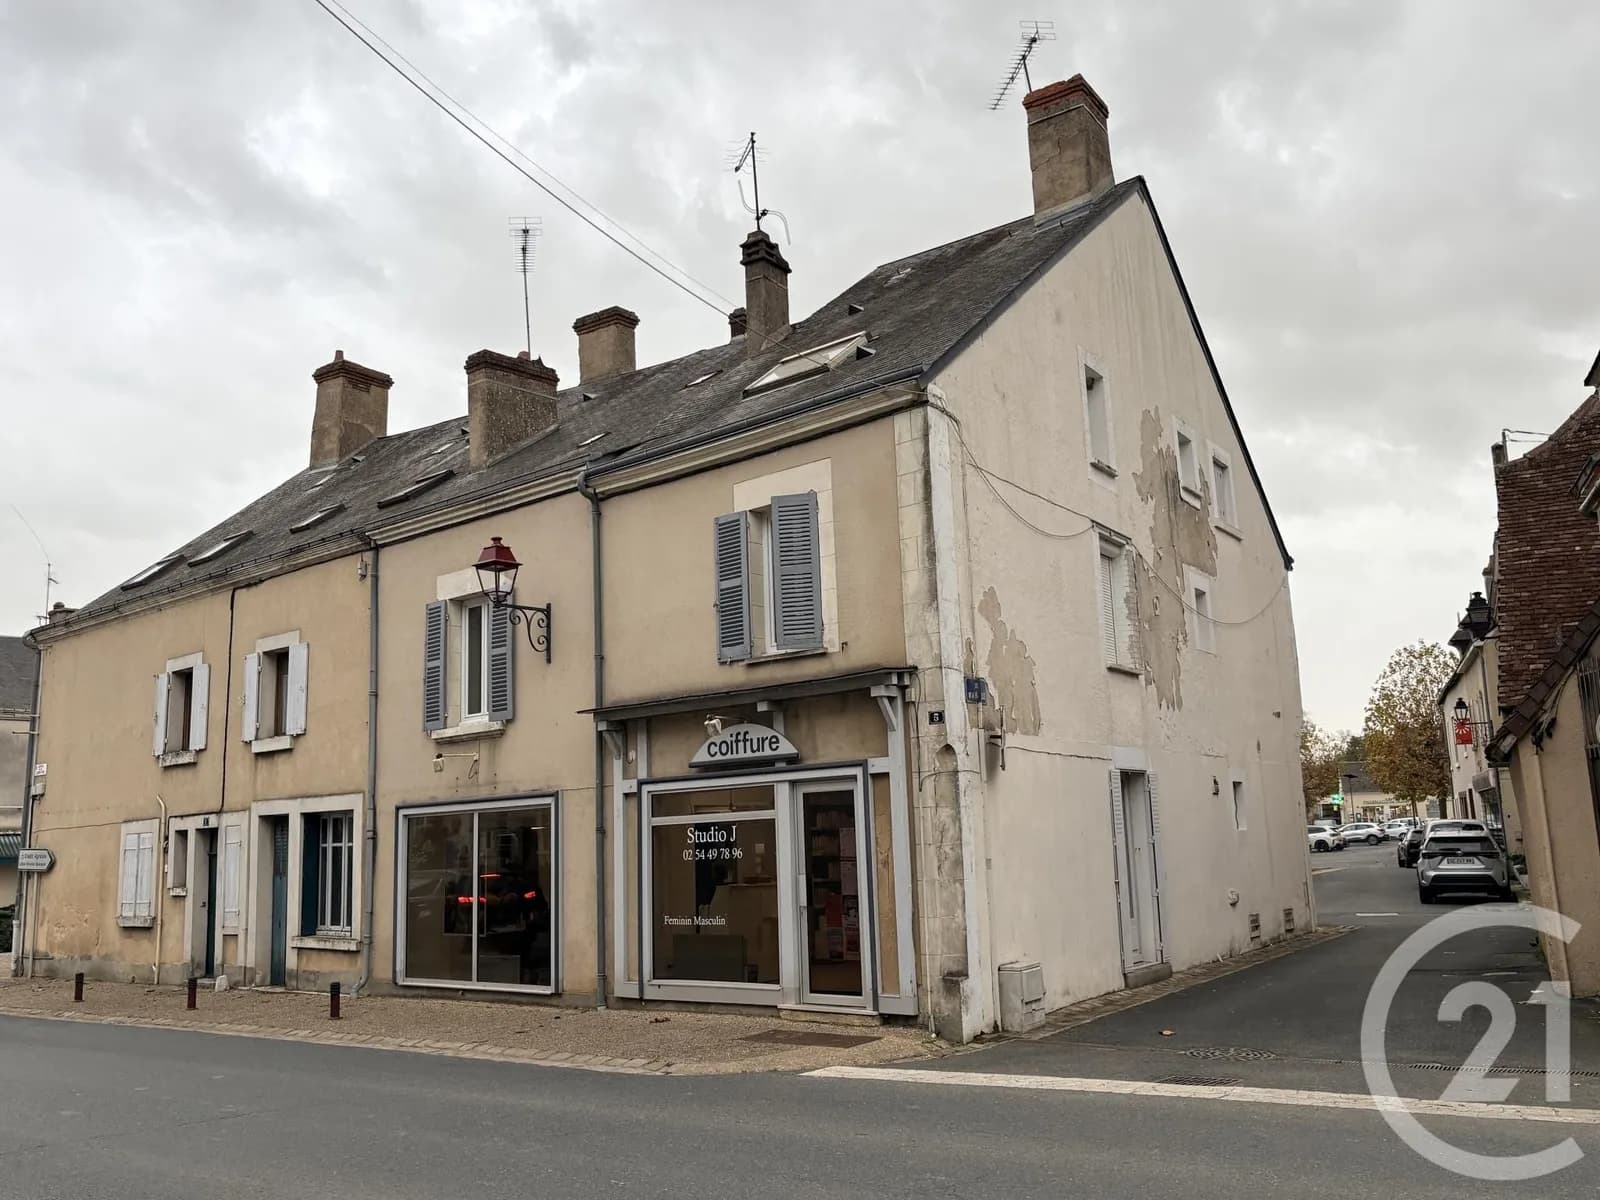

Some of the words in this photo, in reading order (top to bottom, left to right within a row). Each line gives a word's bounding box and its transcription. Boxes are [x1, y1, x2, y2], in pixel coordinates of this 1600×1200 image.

[707, 730, 780, 758] coiffure
[687, 826, 727, 844] Studio
[730, 825, 737, 842] J
[682, 849, 693, 861] 02
[695, 848, 705, 861] 54
[706, 848, 718, 860] 49
[719, 847, 730, 860] 78
[731, 847, 743, 859] 96
[693, 915, 726, 926] Masculin
